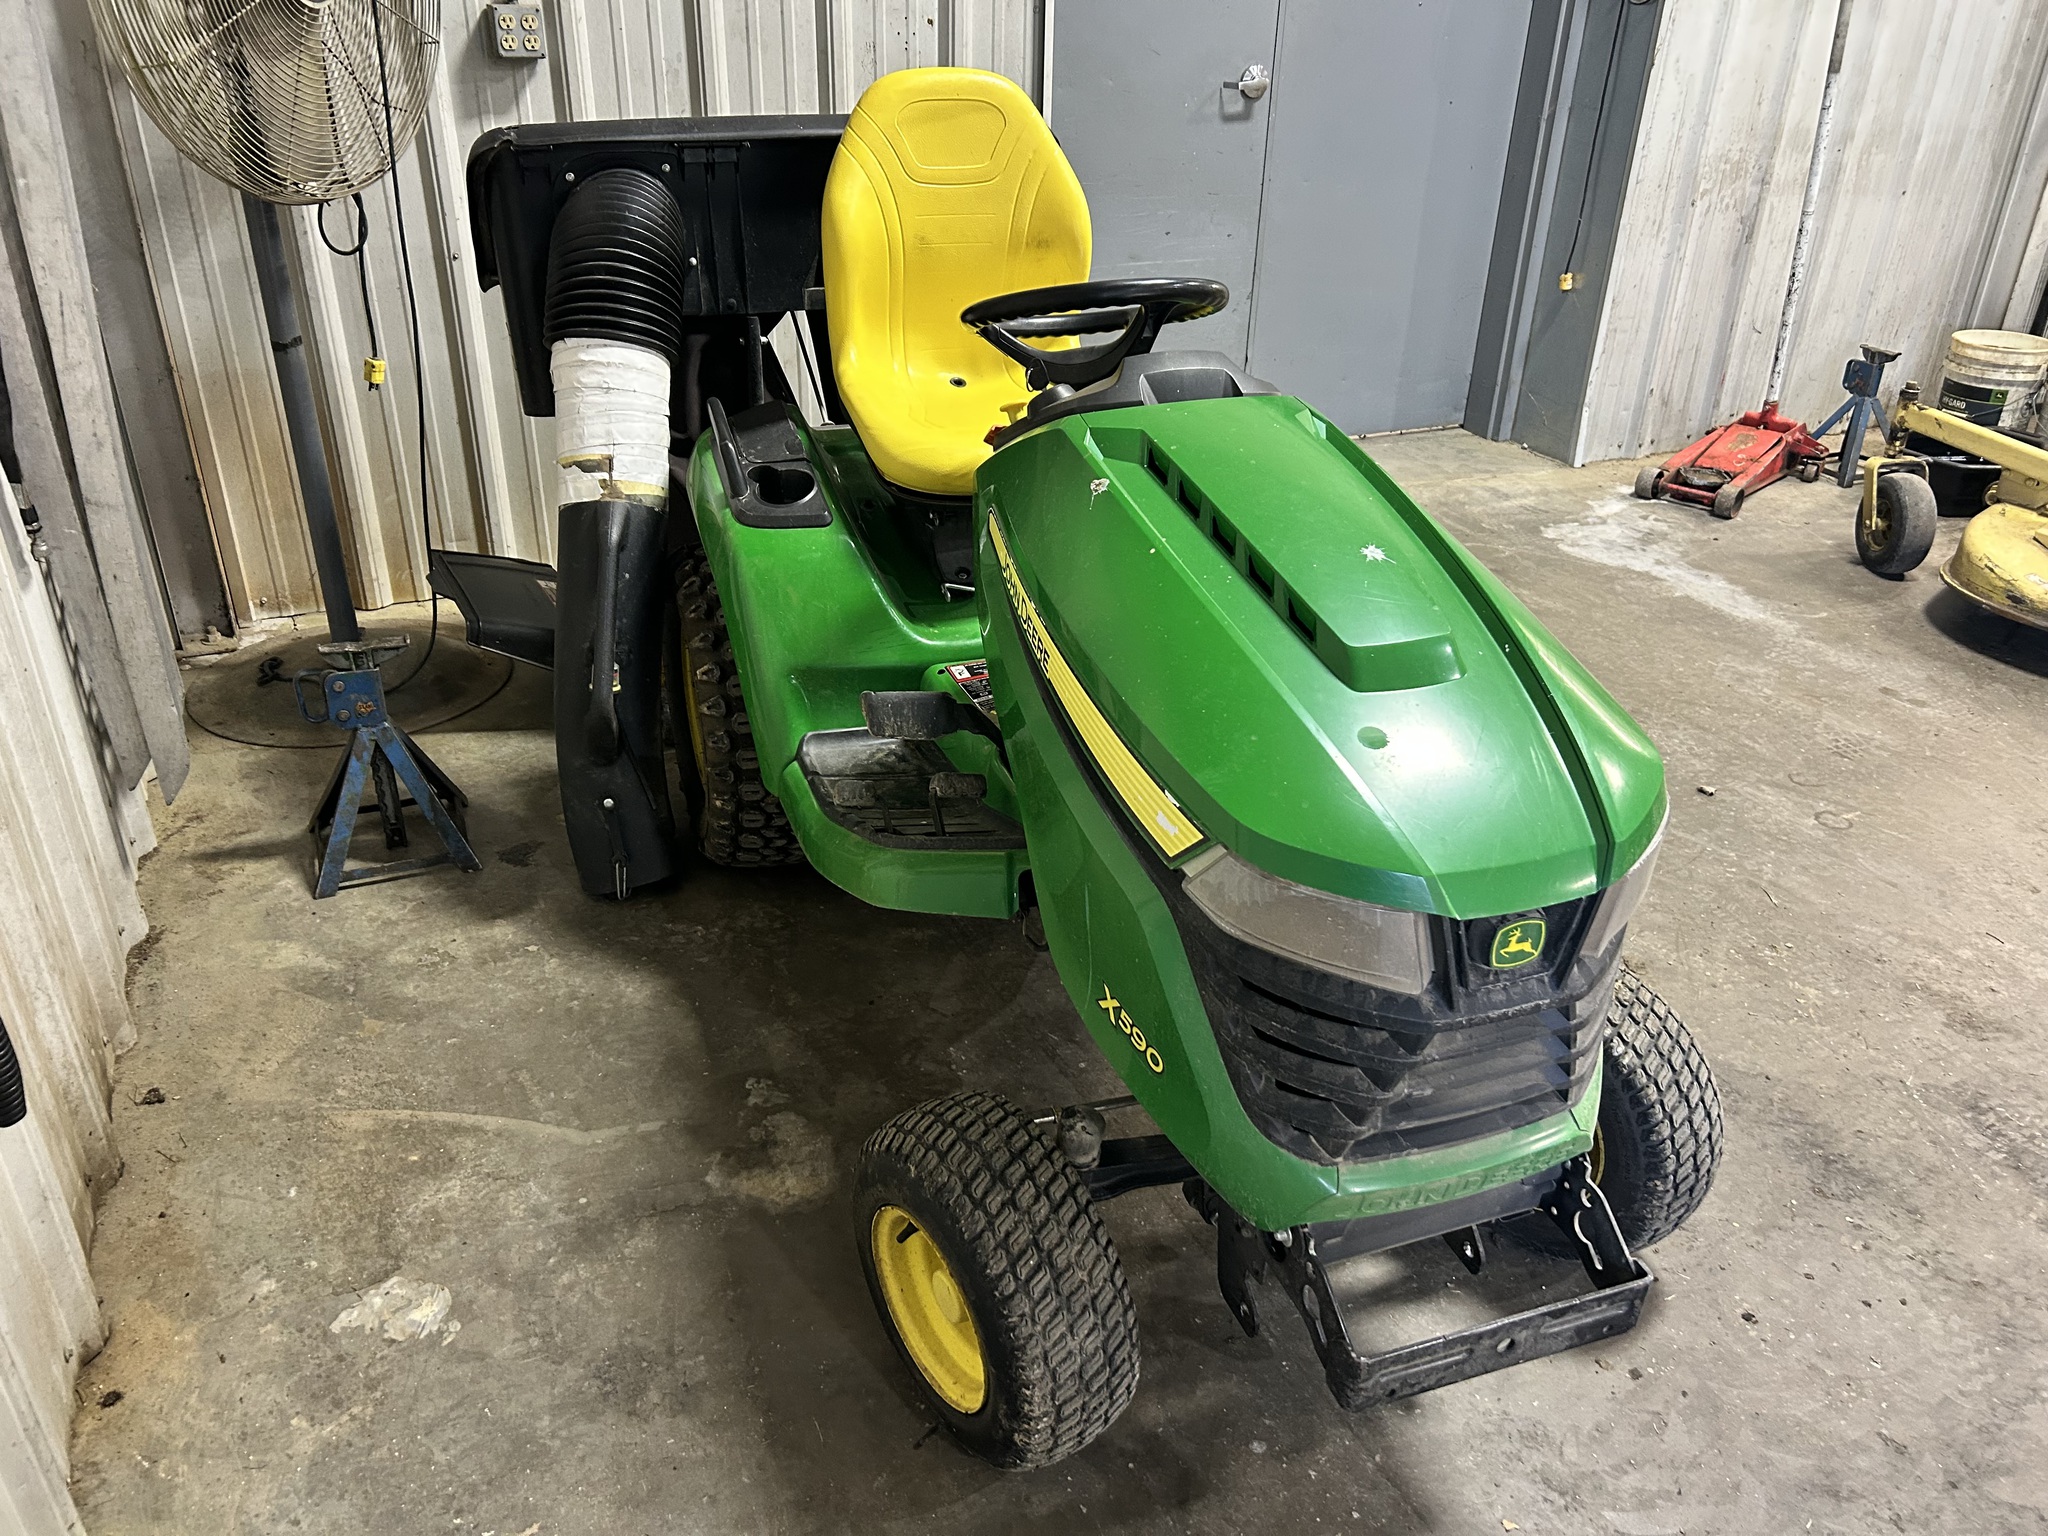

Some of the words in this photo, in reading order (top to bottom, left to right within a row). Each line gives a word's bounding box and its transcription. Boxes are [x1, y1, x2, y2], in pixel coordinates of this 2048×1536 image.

[1001, 553, 1022, 616] JOHN
[1021, 596, 1050, 677] DEERE
[1097, 982, 1164, 1074] X590
